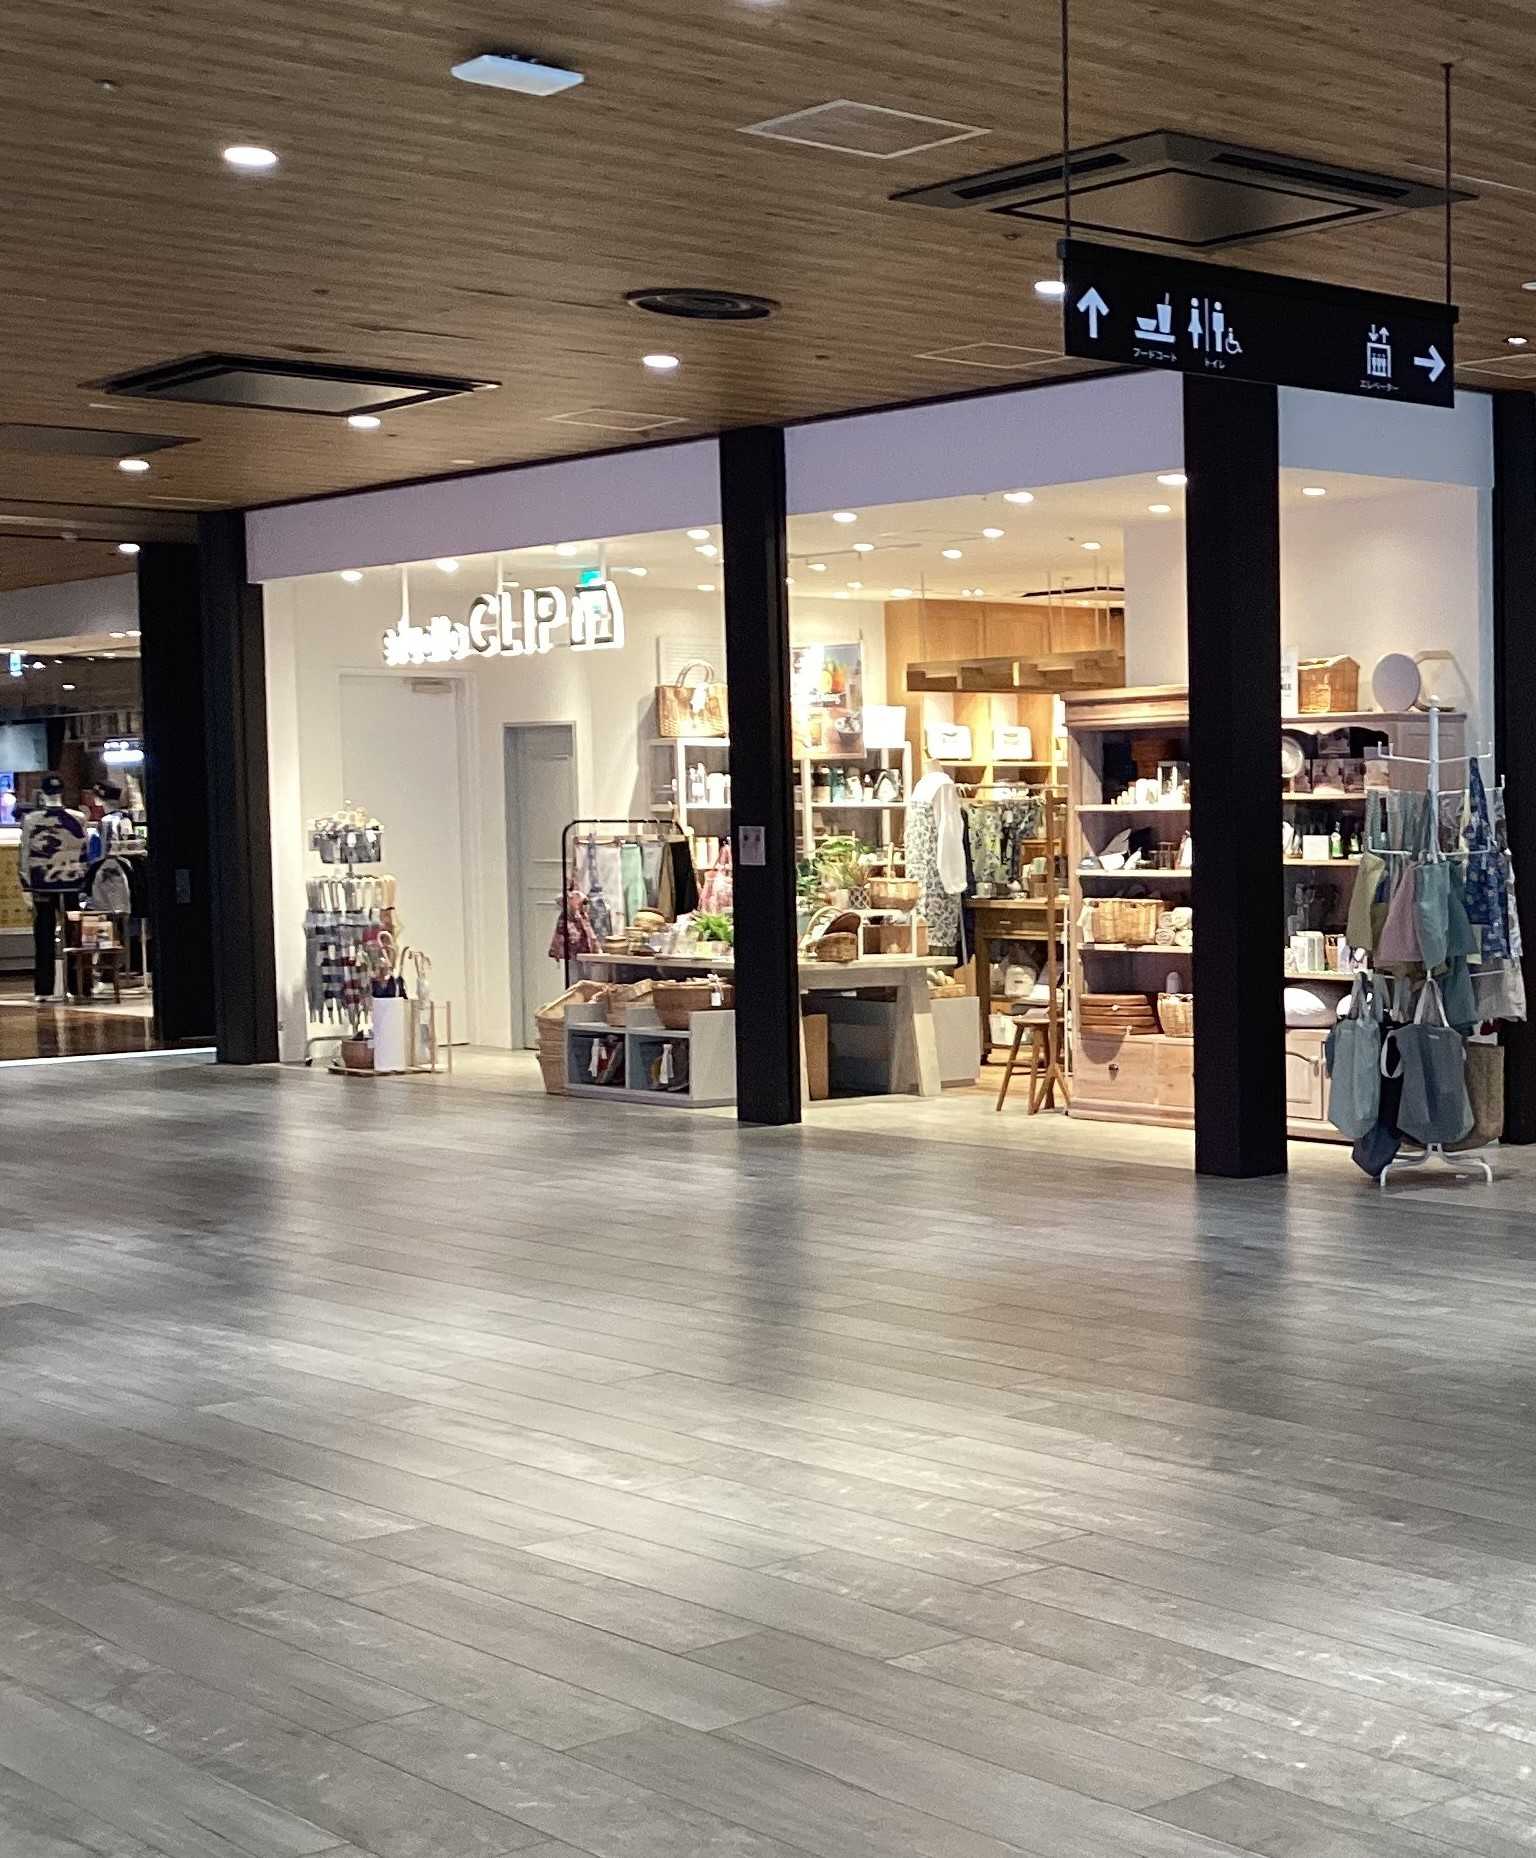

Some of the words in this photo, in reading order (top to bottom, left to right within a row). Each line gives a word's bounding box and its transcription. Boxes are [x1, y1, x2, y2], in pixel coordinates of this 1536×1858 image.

[1132, 347, 1178, 363] フードコート
[1204, 358, 1226, 370] トイレ
[469, 585, 568, 658] CLIP
